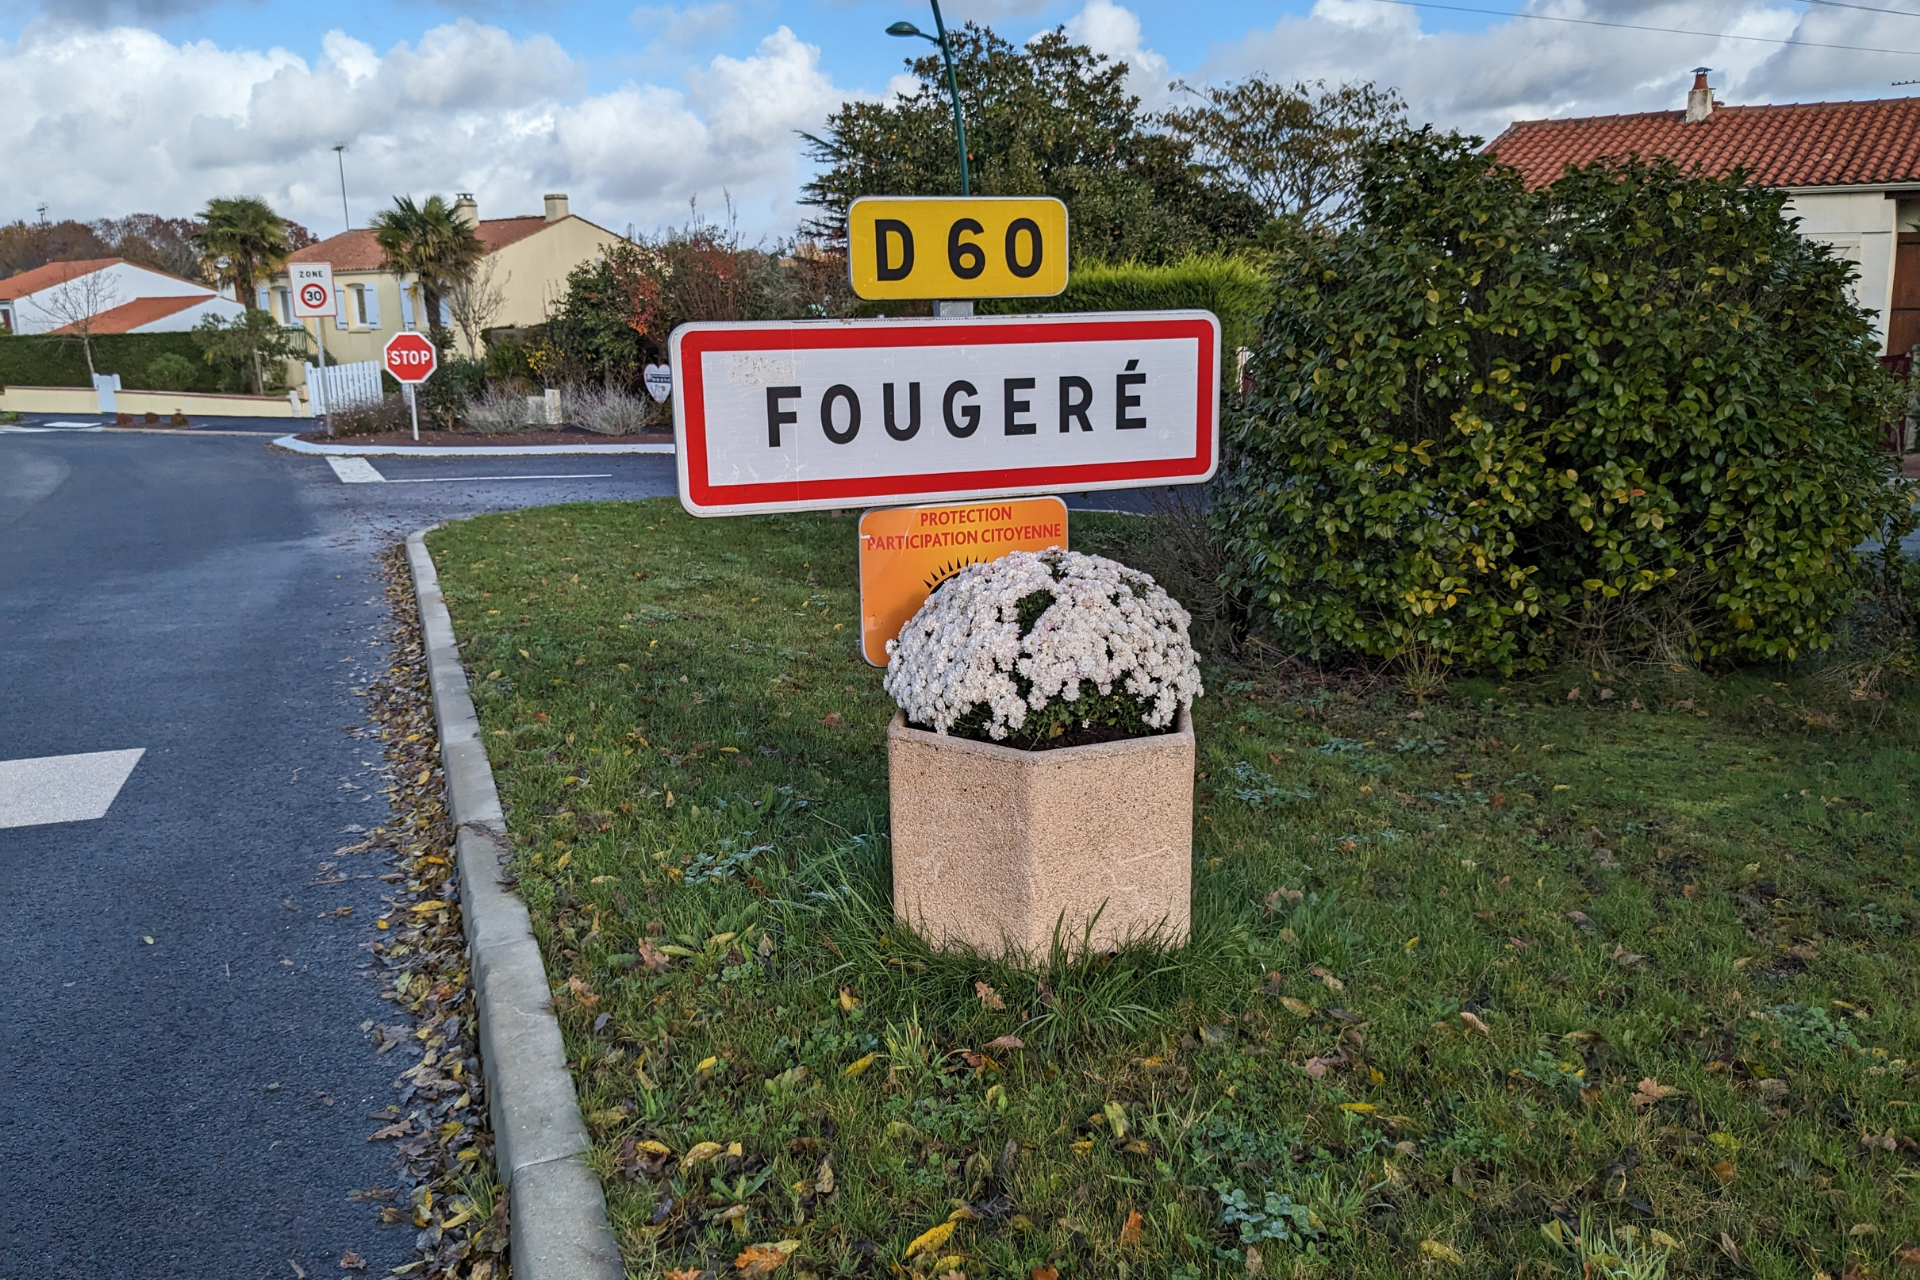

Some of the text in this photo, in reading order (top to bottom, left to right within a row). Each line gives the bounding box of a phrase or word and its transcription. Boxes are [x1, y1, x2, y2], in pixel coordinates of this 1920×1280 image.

[875, 217, 1043, 282] D 60
[299, 270, 323, 278] ZONE
[306, 291, 322, 301] 30
[390, 350, 430, 365] STOP
[766, 359, 1147, 447] FOUGERÉ
[920, 506, 1012, 527] PROTECTION
[867, 523, 1061, 551] PARTICIPATION CITOYENNE
